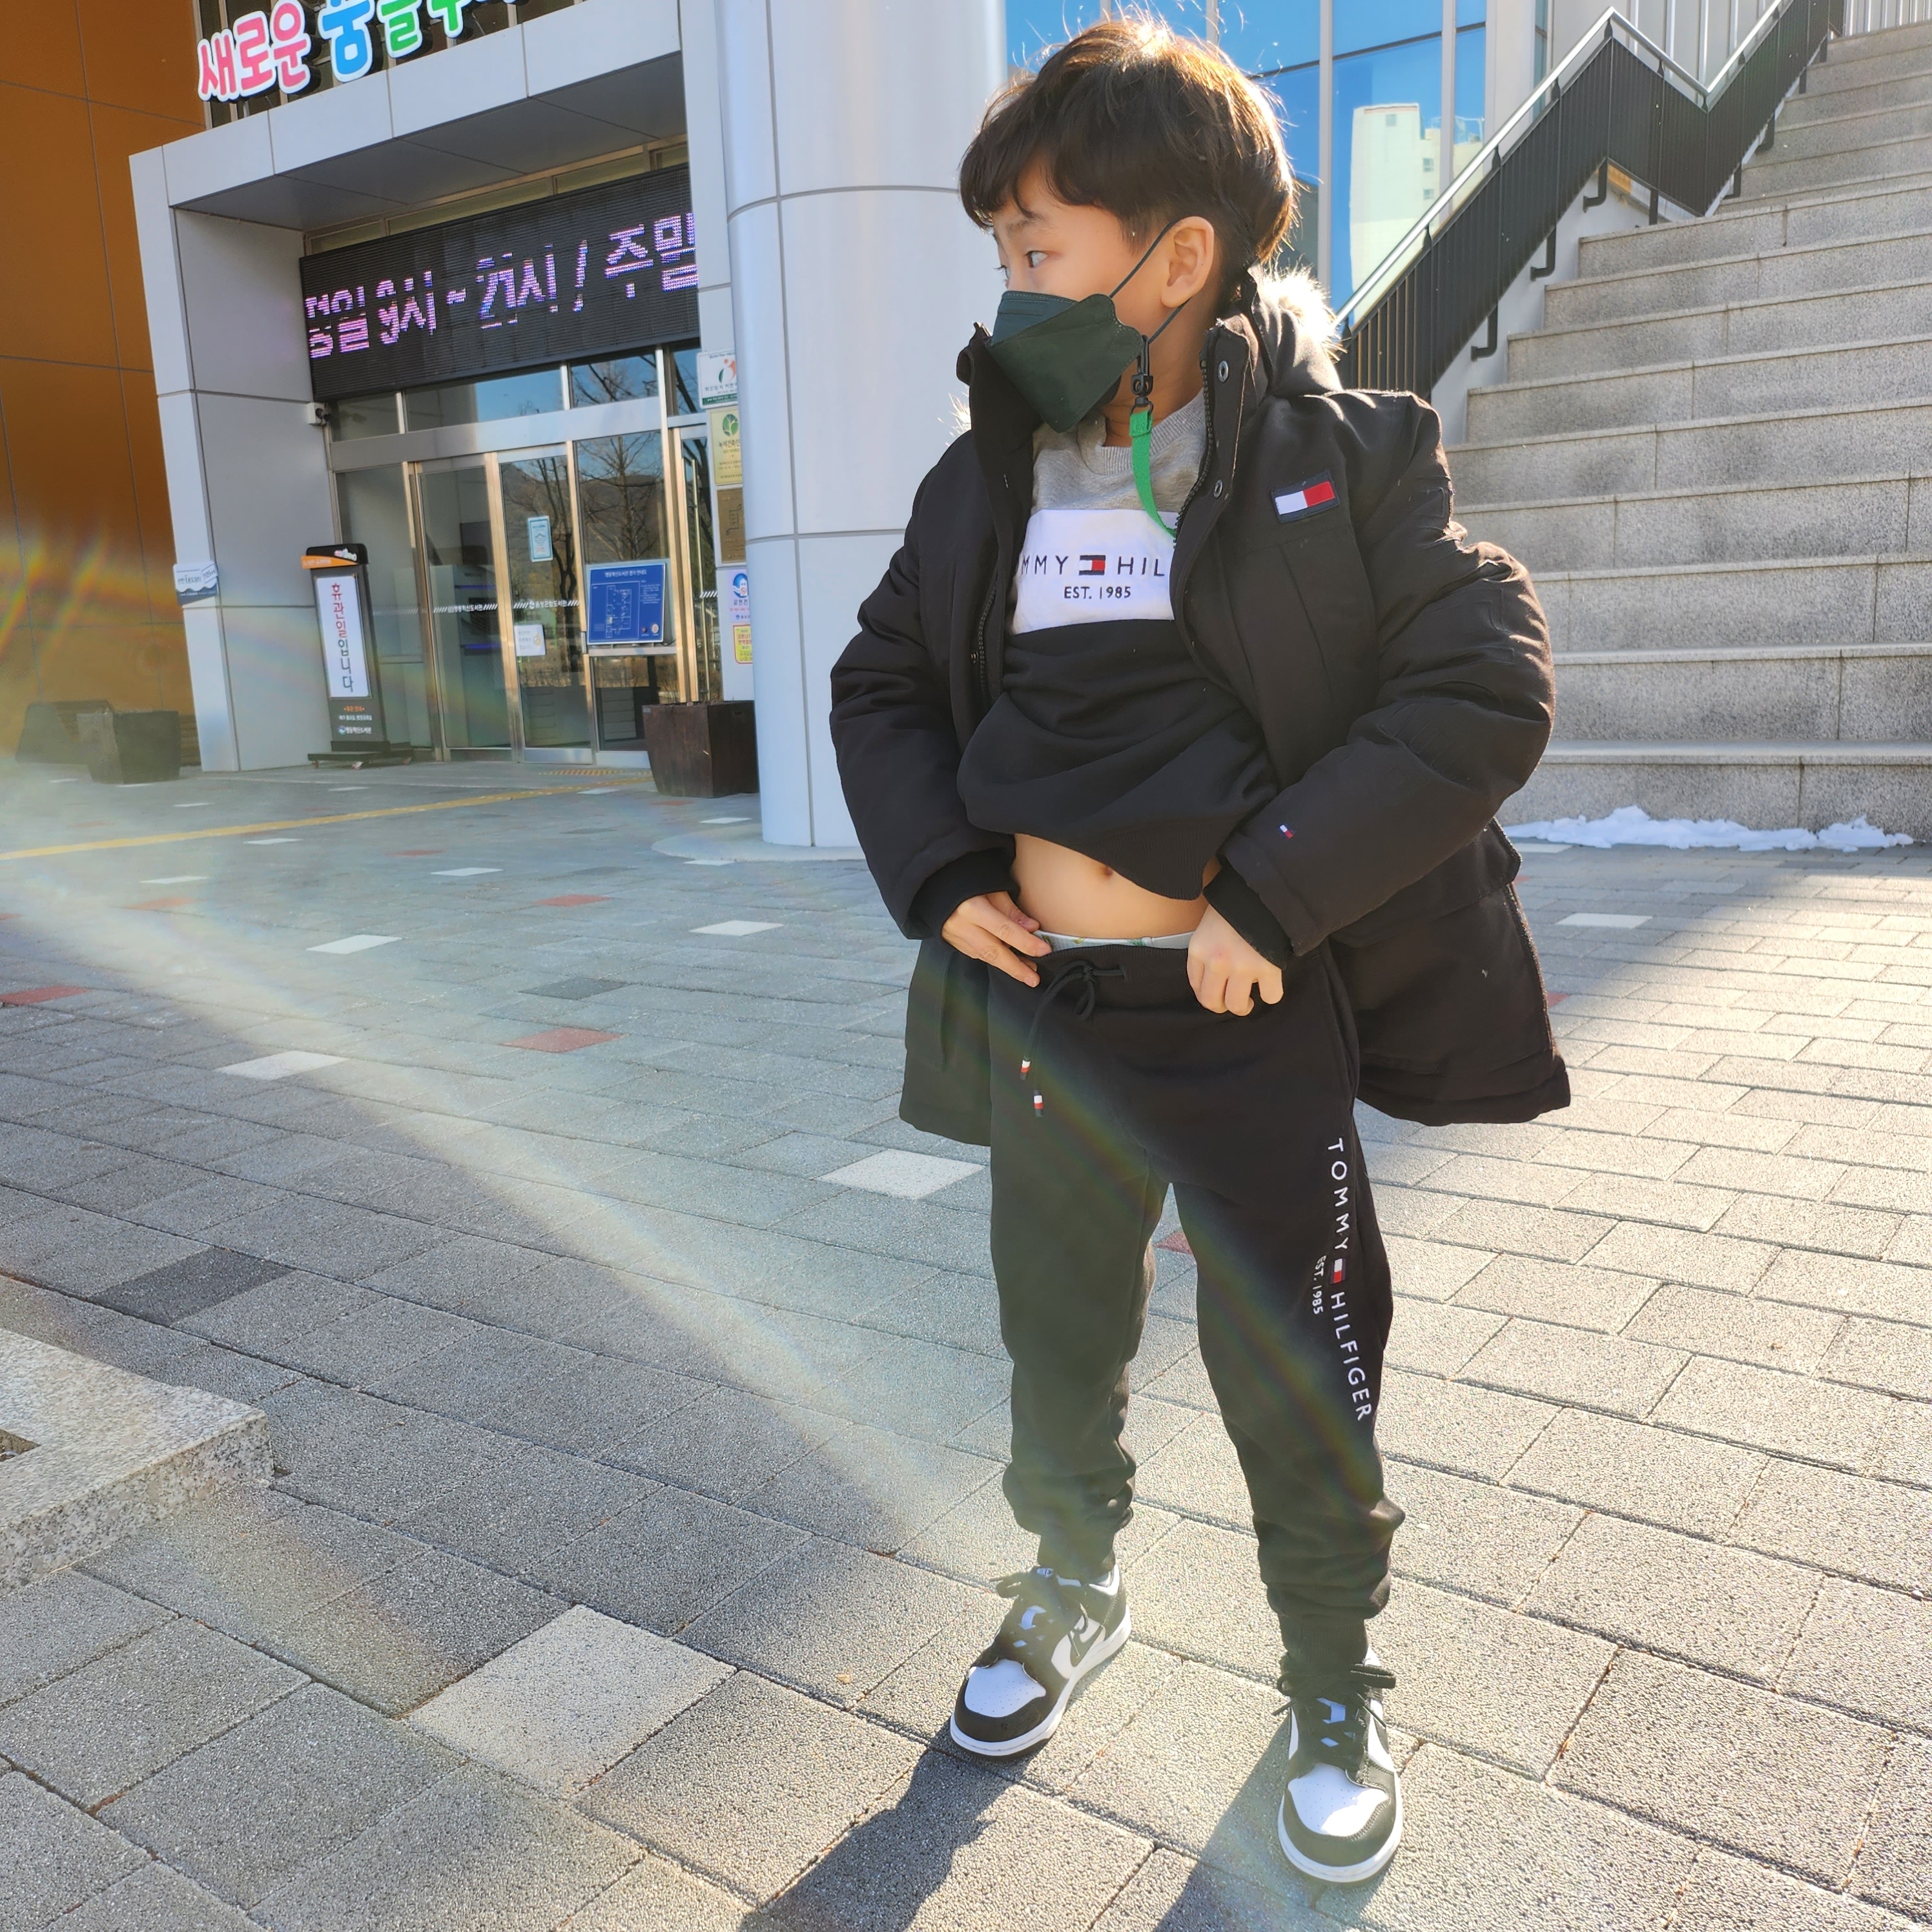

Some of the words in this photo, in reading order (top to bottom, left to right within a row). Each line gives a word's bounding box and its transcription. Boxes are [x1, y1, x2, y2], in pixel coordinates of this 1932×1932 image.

[198, 0, 310, 99] 새로운
[1064, 586, 1092, 600] EST.
[1099, 586, 1131, 600] 1985
[1117, 556, 1165, 577] HIL
[331, 582, 354, 693] 휴관일입니다
[1326, 1137, 1351, 1251] TOMMY
[1311, 1285, 1324, 1315] 1985
[1313, 1254, 1328, 1282] EST.
[1330, 1291, 1373, 1422] HILFIGER
